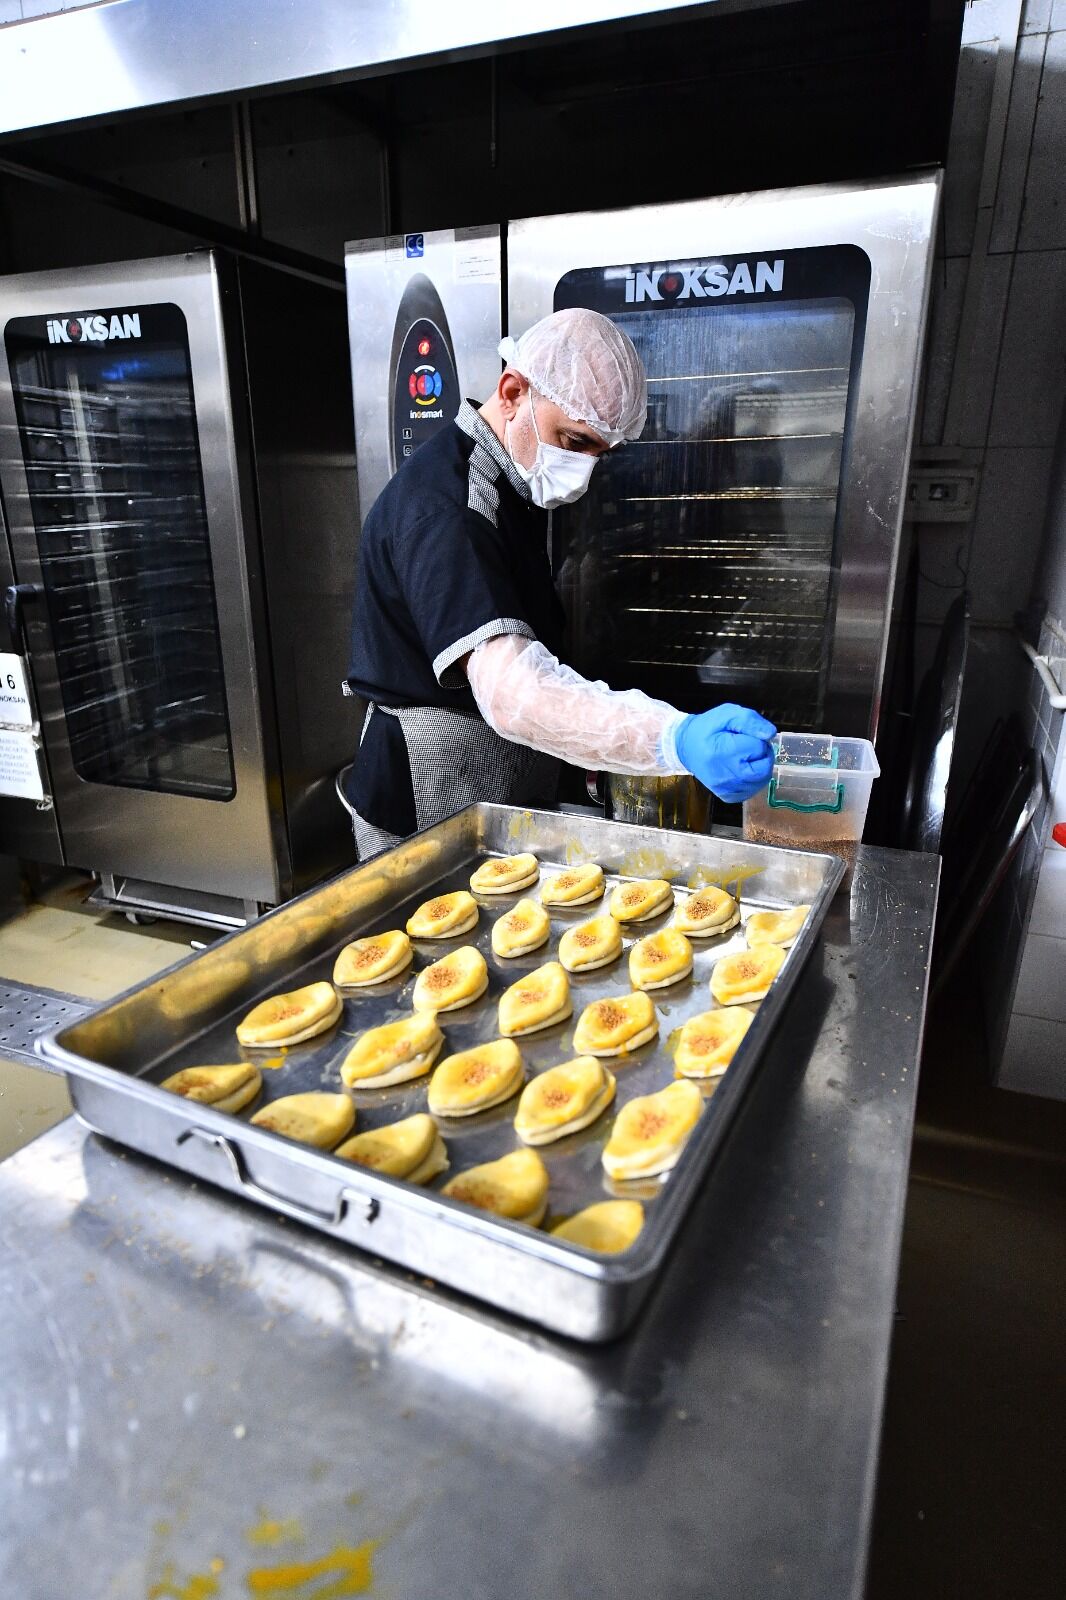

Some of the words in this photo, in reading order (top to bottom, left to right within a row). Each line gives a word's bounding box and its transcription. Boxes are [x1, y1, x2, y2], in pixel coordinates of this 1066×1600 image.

[407, 235, 424, 251] CE
[410, 409, 443, 419] inosmart
[7, 674, 16, 690] 6
